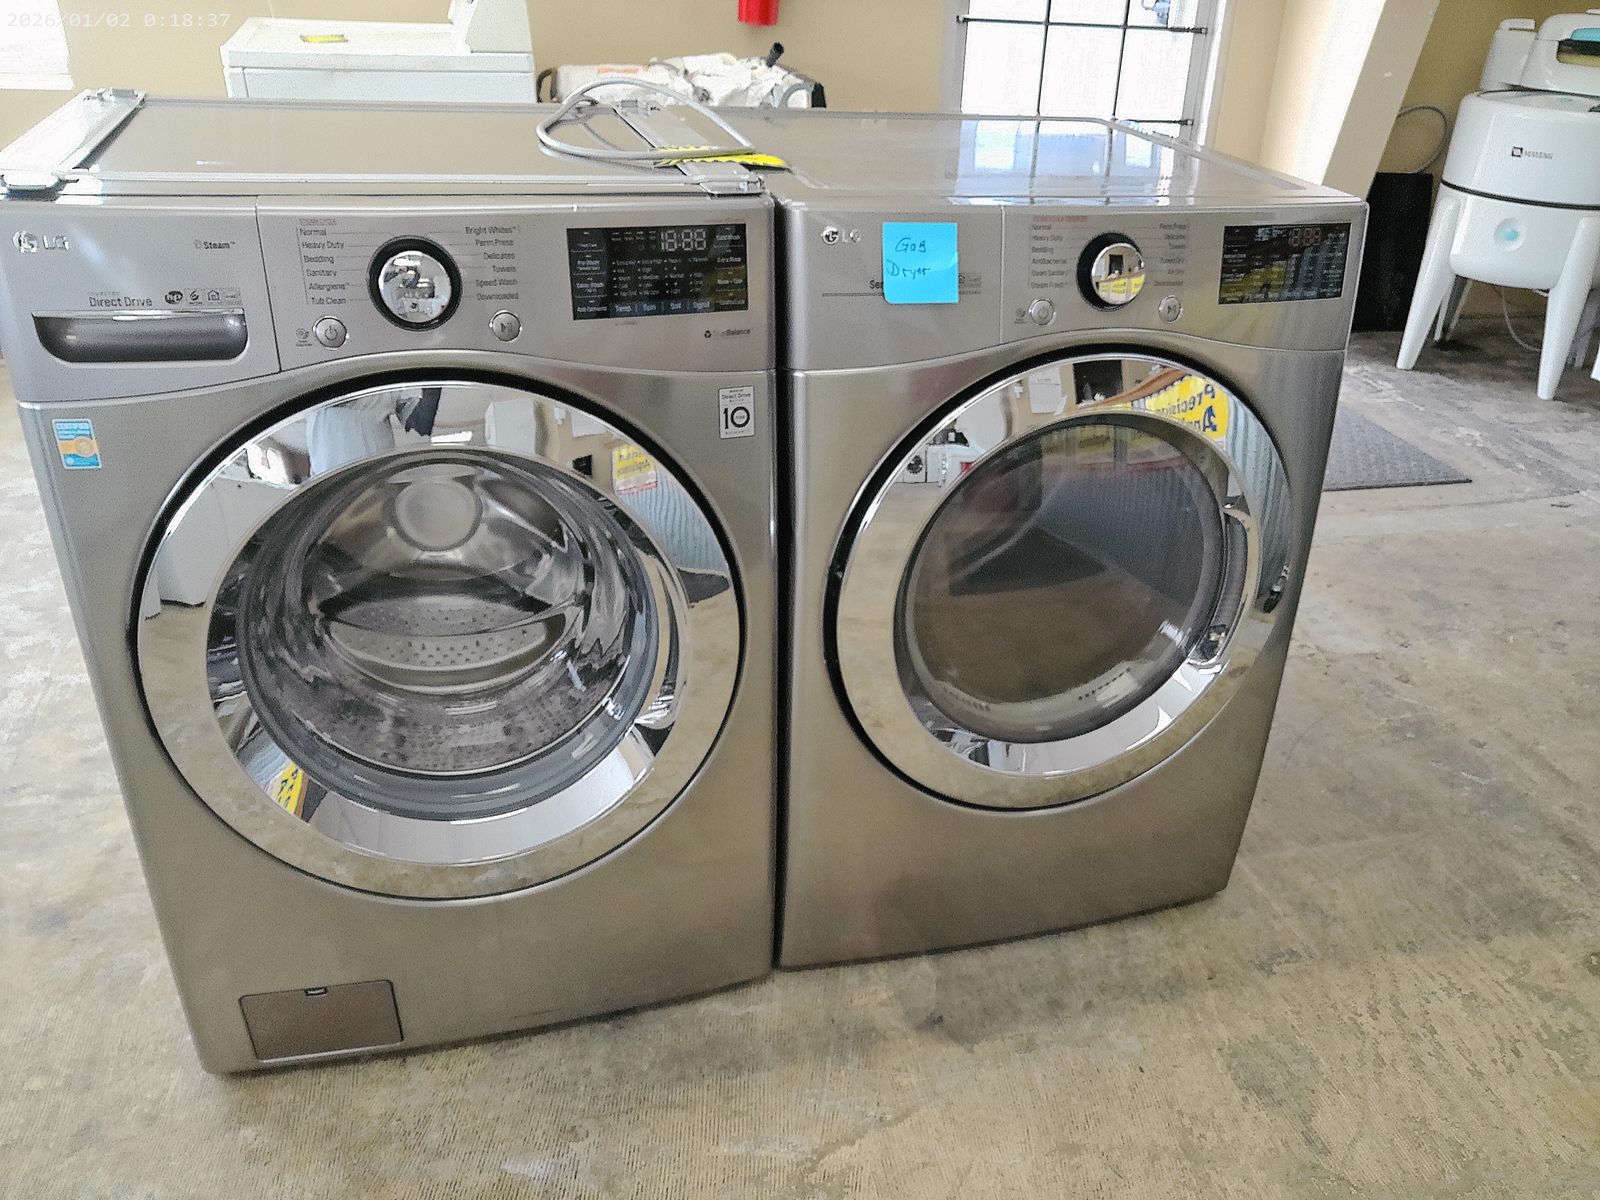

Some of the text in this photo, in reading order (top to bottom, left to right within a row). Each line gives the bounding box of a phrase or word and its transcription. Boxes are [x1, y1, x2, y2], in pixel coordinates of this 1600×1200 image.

[42, 235, 70, 250] LG
[886, 259, 931, 280] Dryer
[869, 279, 884, 290] Se
[89, 296, 122, 308] Direct
[123, 297, 153, 307] Drive
[723, 406, 751, 430] 10
